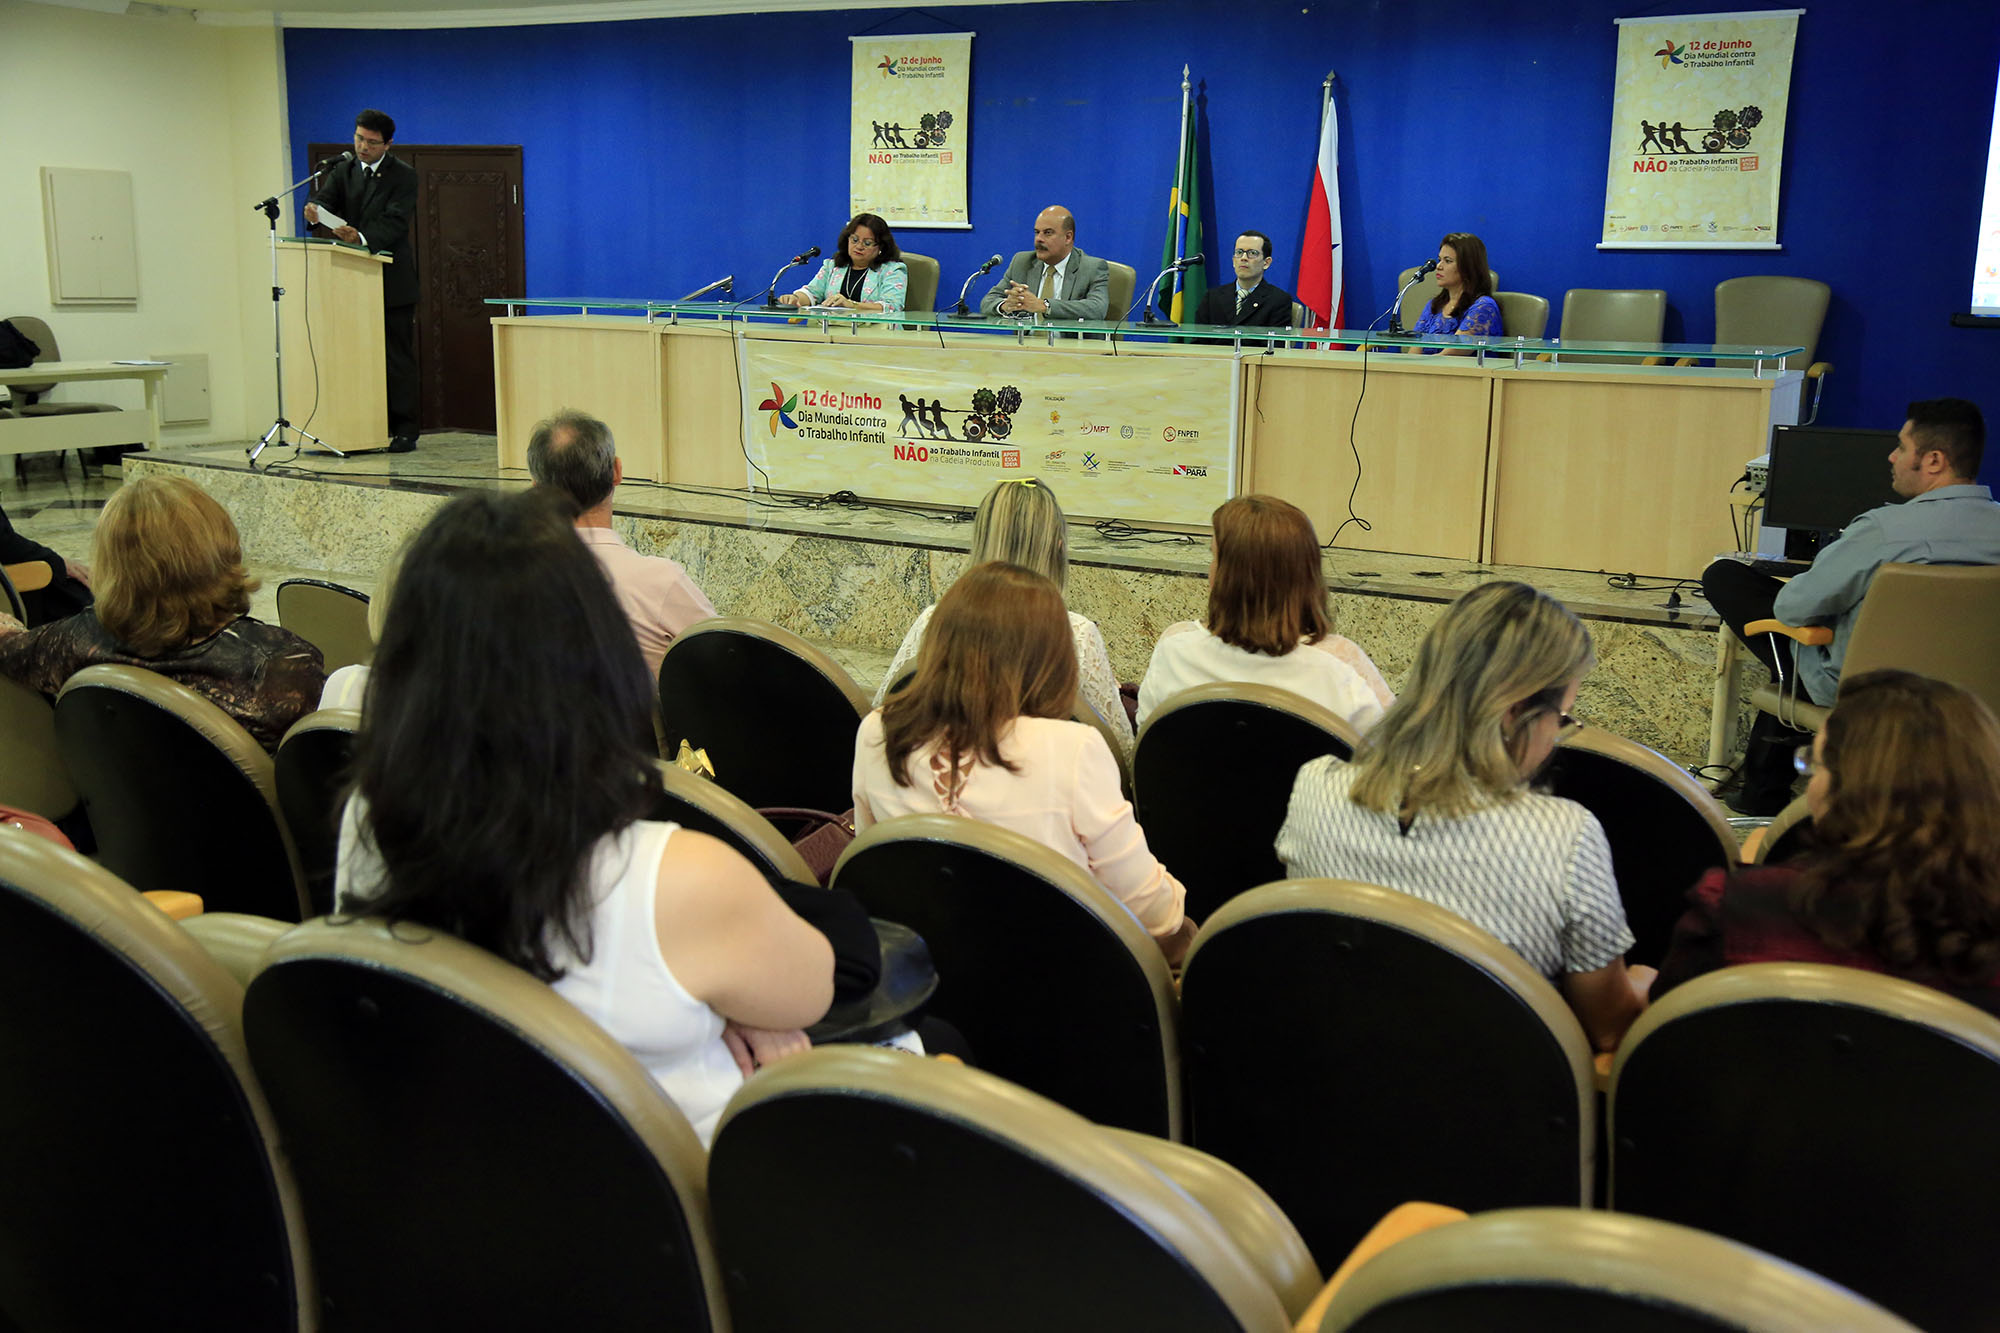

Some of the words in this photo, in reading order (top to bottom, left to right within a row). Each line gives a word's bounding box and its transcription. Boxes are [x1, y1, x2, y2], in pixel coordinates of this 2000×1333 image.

[1689, 41, 1700, 50] 12
[1703, 40, 1717, 50] de
[1718, 39, 1752, 51] Junho
[910, 56, 919, 64] de
[920, 56, 942, 65] Junho
[1724, 58, 1754, 66] Infantil
[868, 152, 892, 164] NÃO
[1633, 157, 1668, 173] NÃO
[802, 390, 817, 406] 12
[820, 390, 838, 408] de
[838, 392, 882, 411] Junho
[798, 410, 812, 422] Dia
[814, 412, 853, 426] Mundial
[854, 416, 887, 428] contra
[798, 428, 805, 438] o
[806, 427, 848, 441] Trabalho
[850, 430, 886, 444] Infantil
[1177, 430, 1199, 438] FNPETI
[894, 442, 928, 462] NÃO
[940, 448, 970, 457] Trabalho
[972, 450, 1000, 458] Infantil
[965, 458, 1000, 467] Produtiva
